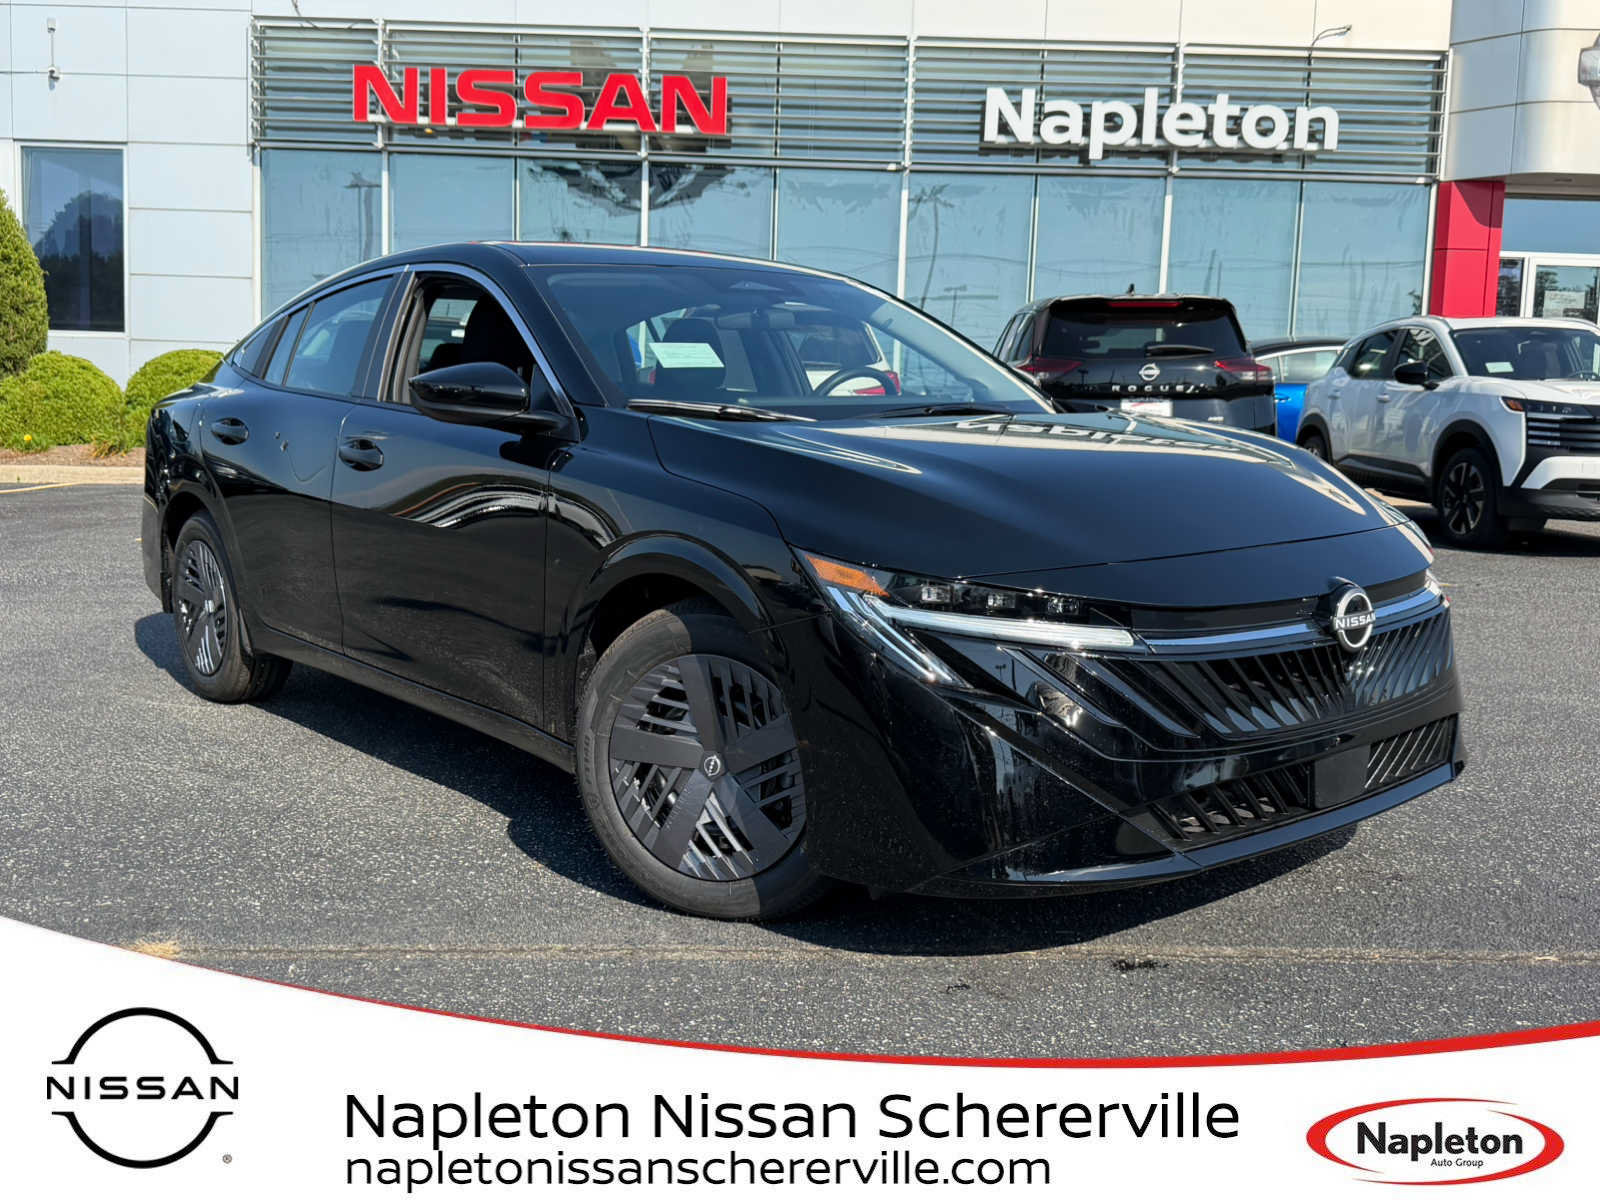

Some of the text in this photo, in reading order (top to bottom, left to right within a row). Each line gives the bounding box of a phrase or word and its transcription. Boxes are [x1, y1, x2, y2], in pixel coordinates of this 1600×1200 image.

[353, 64, 728, 135] NISSAN
[983, 87, 1340, 160] Napleton
[1335, 612, 1376, 629] NISSAN
